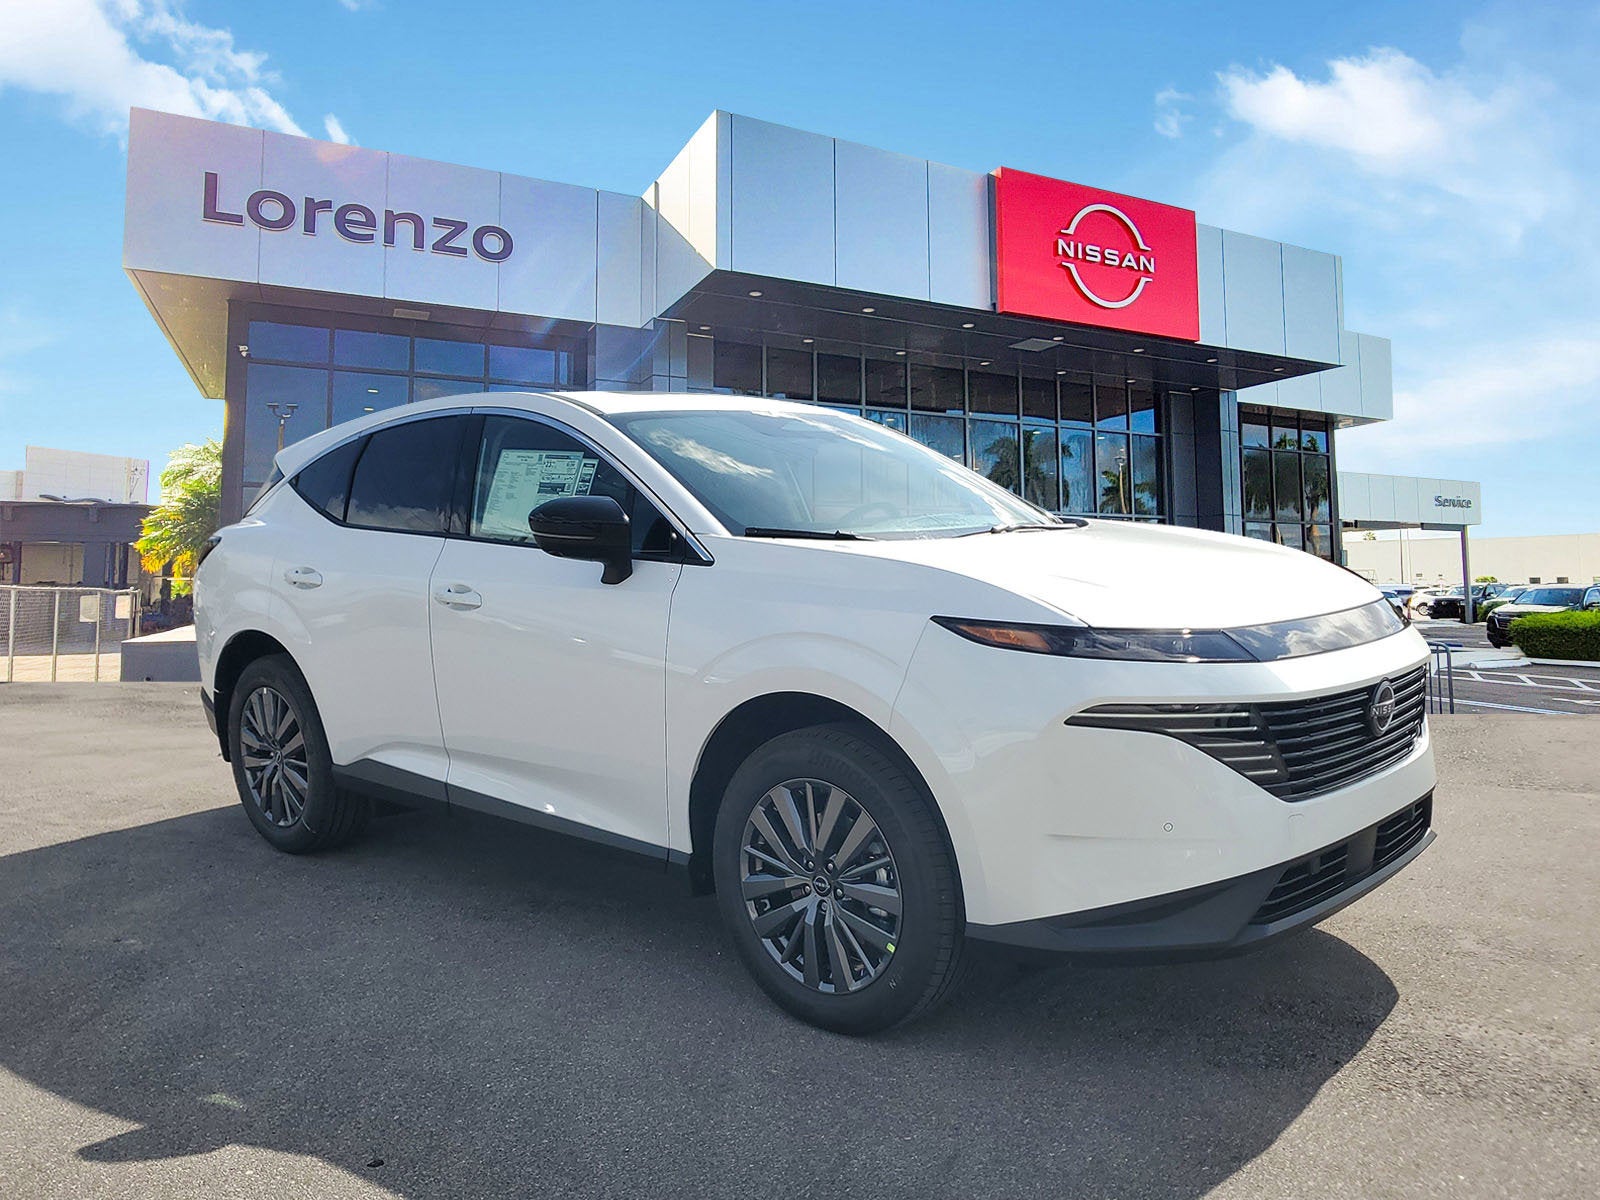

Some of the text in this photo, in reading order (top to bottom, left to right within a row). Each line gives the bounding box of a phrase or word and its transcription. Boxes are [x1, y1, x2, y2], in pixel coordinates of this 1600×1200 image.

[203, 171, 514, 262] Lorenzo
[1057, 238, 1155, 273] NISSAN
[1434, 495, 1472, 508] Service
[1372, 704, 1394, 715] NISS
